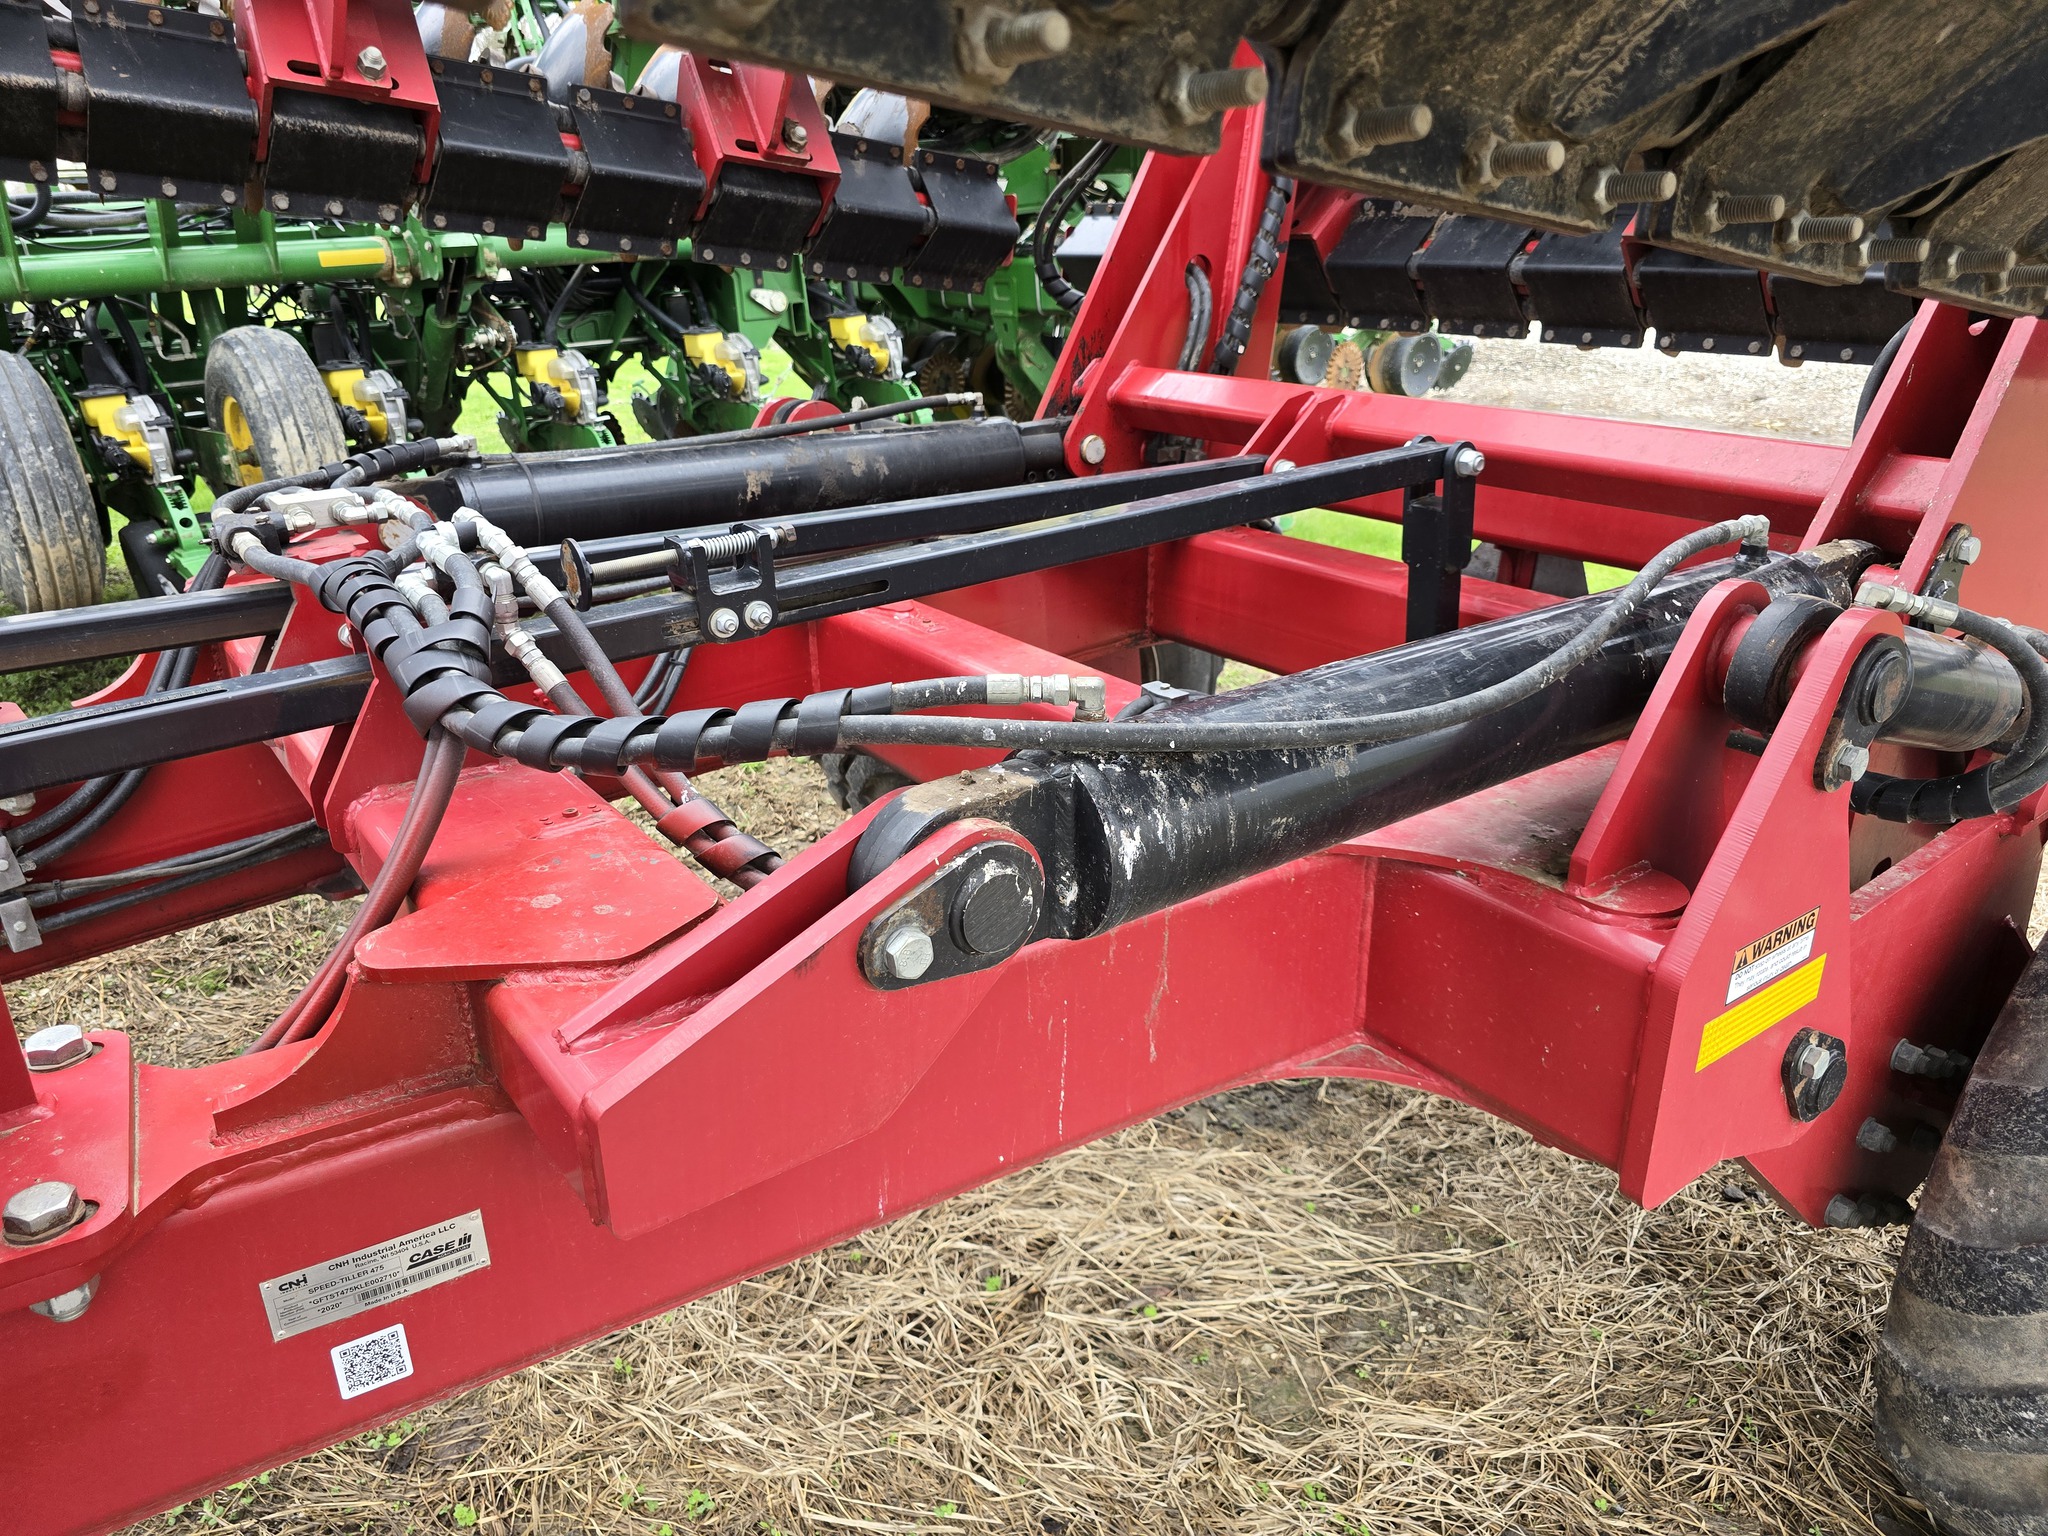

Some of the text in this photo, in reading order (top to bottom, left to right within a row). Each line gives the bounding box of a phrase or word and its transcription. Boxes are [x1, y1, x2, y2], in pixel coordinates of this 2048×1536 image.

[1752, 912, 1816, 960] WARNING
[1743, 964, 1755, 975] NOT
[328, 1222, 456, 1271] CNH Industrial America LLC
[354, 1257, 379, 1269] Racine,
[412, 1239, 431, 1249] U.S.A.
[409, 1240, 456, 1263] CASE
[308, 1265, 385, 1294] SPEED-TILLER 475
[364, 1297, 382, 1307] Made
[390, 1288, 409, 1298] U.S.A.
